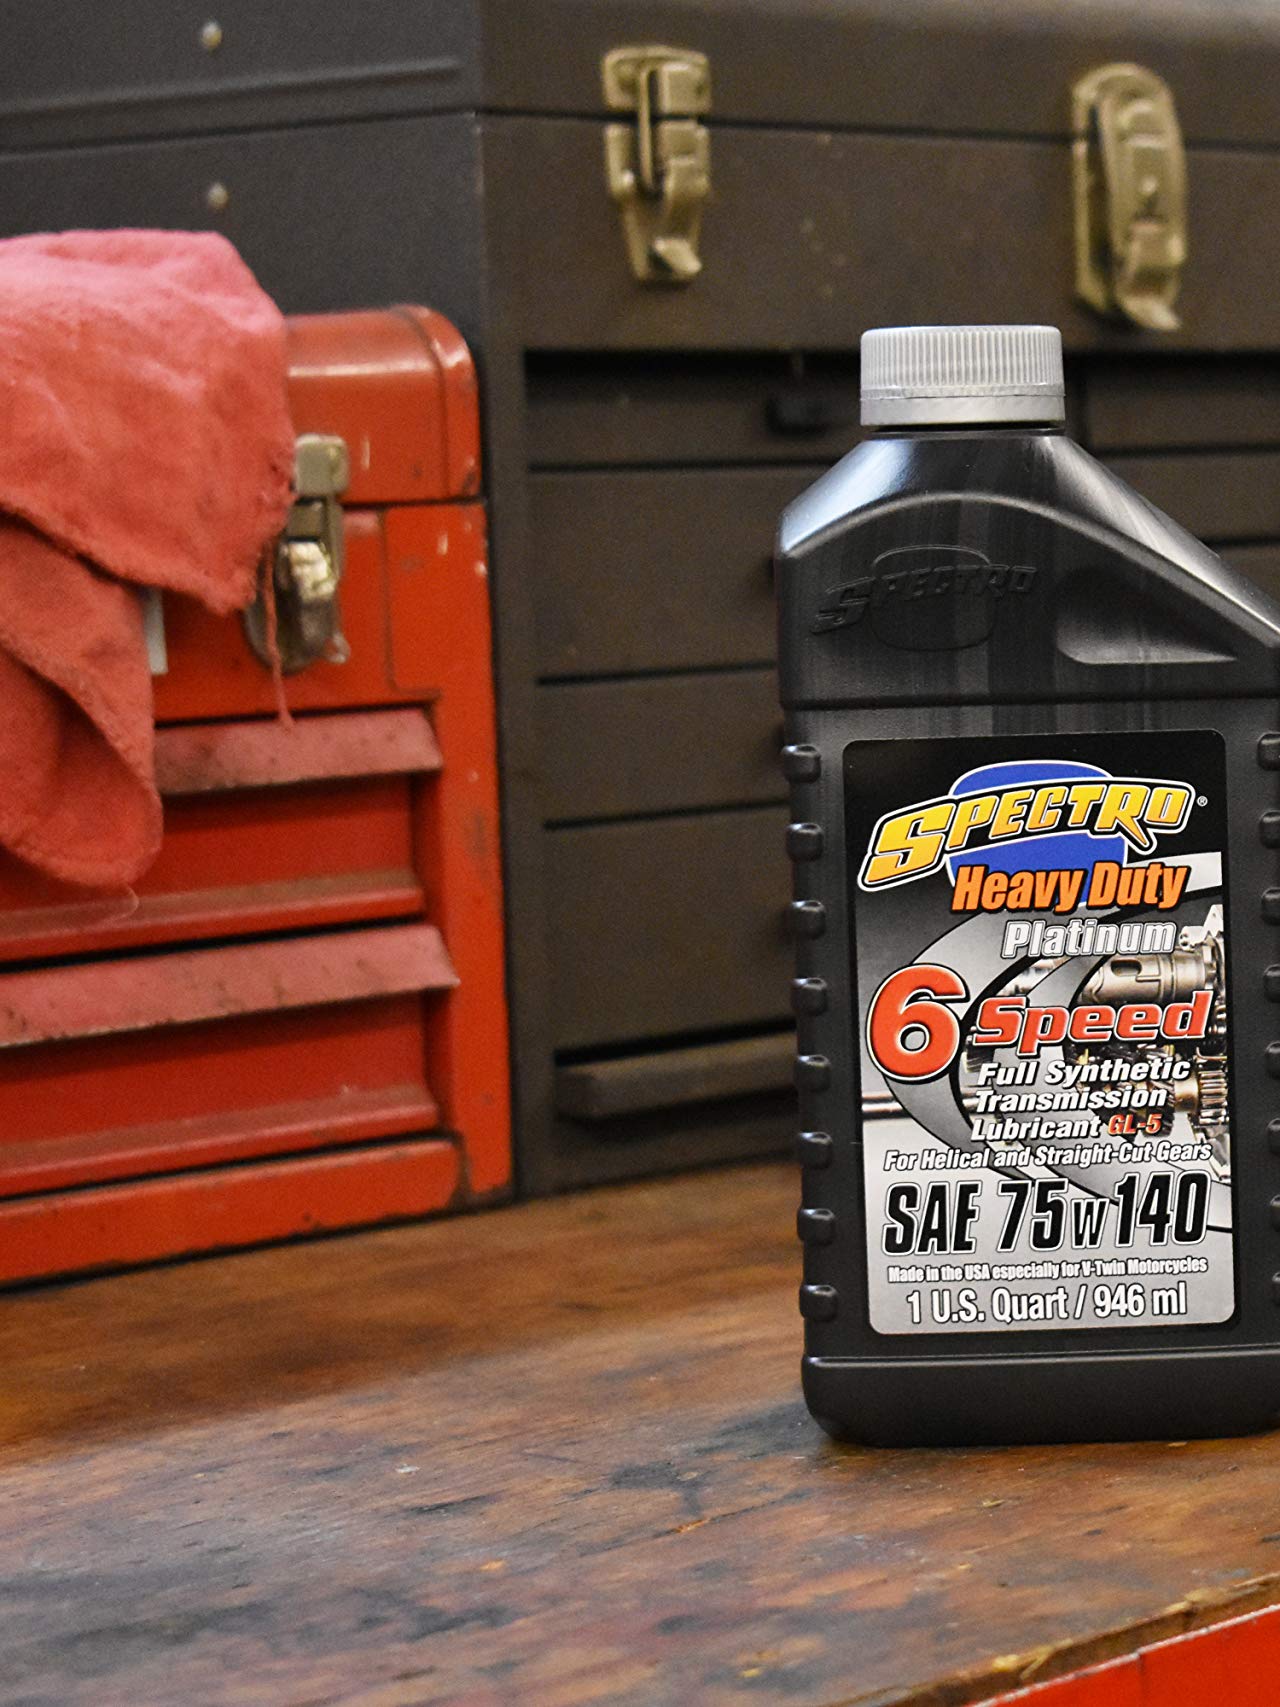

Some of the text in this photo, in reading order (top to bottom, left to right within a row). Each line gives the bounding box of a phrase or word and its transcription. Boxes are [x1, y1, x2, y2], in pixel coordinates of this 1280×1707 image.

[861, 781, 1192, 886] SPECTRO
[950, 861, 1189, 914] Heavy Duty
[1000, 919, 1178, 959] Platinum
[867, 963, 1213, 1083] 6 Speed
[976, 1056, 1192, 1089] Full Synthetic
[975, 1086, 1169, 1114] Transmission
[970, 1113, 1163, 1142] Lubricant GL-5
[883, 1140, 1212, 1171] For Helical and Straight-Cut Gears
[882, 1180, 983, 1256] SAE
[887, 1255, 1208, 1283] Made in the USA especially for V-Twin Motorcycles
[906, 1280, 1187, 1325] 1 U.S. Quart / 946 ml
